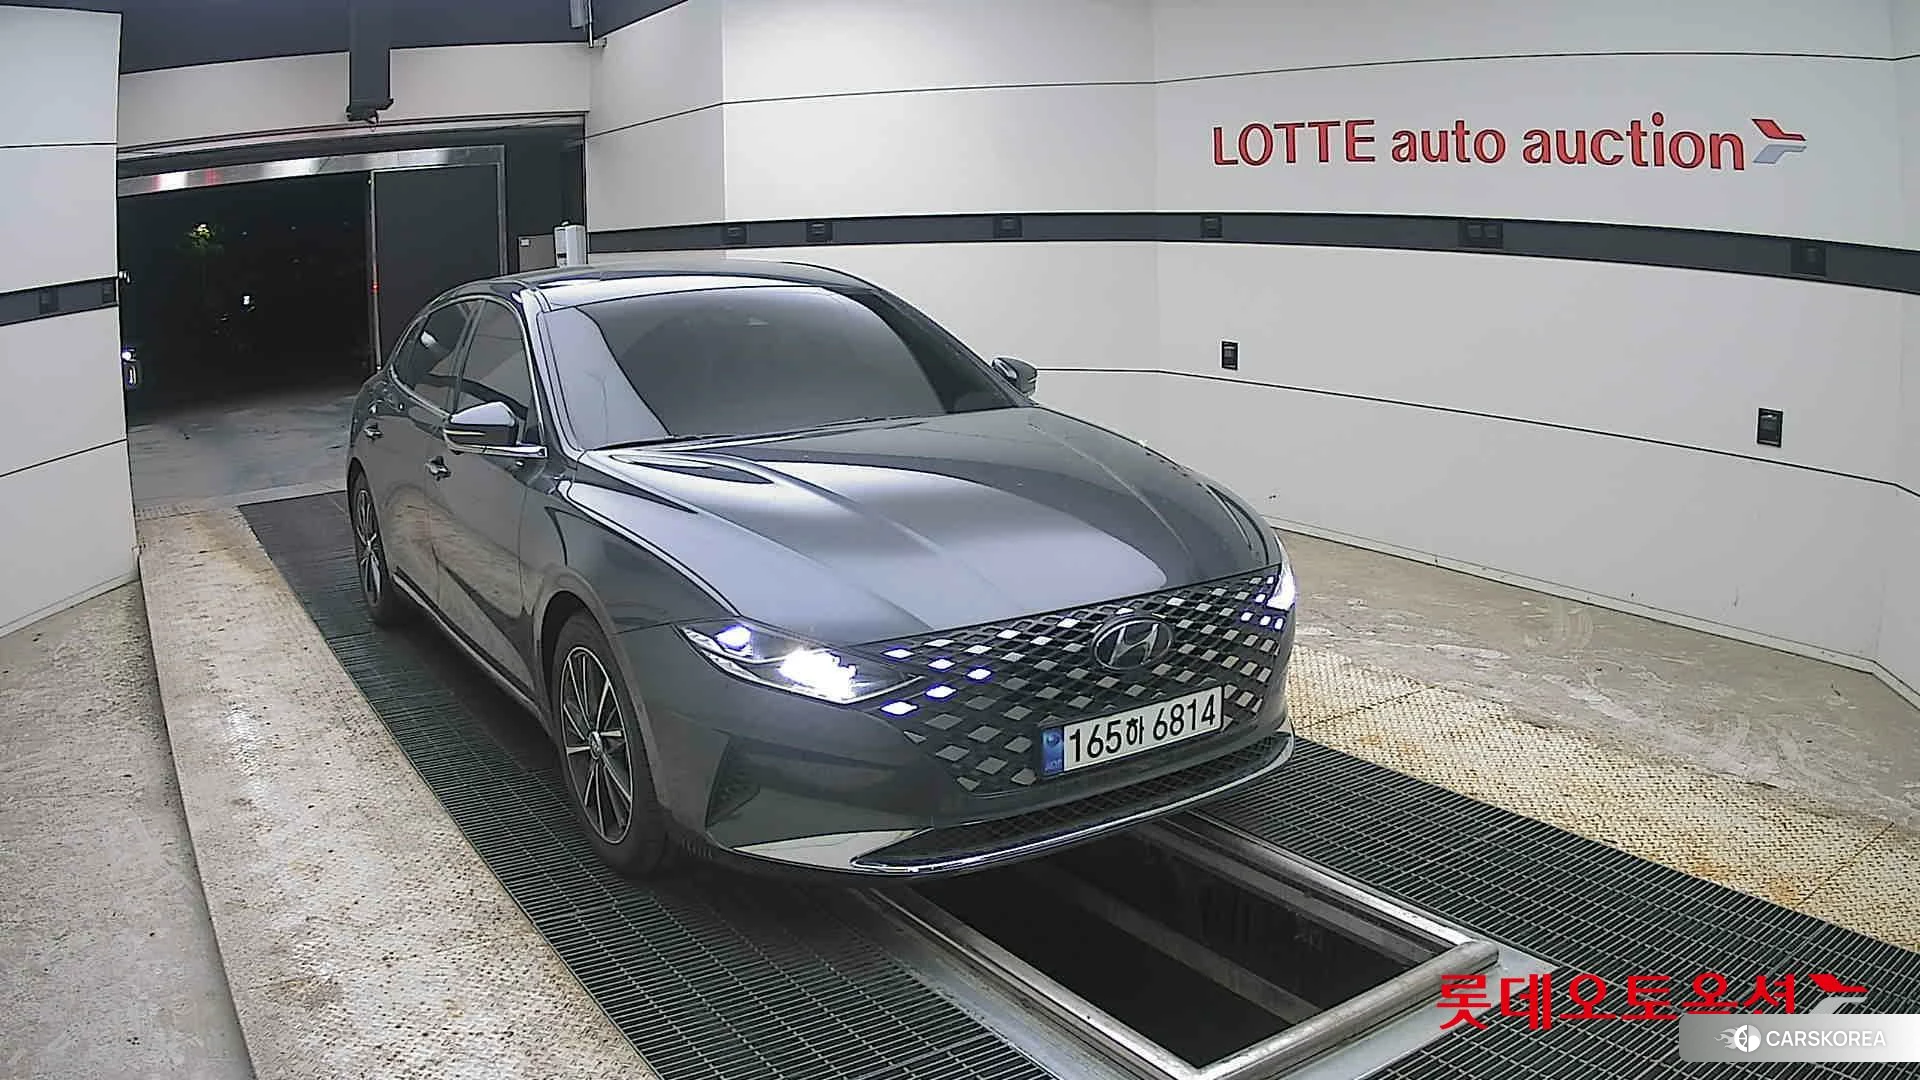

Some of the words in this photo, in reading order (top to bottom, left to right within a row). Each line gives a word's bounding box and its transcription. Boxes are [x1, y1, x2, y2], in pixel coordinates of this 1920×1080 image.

[1212, 119, 1376, 166] LOTTE
[1391, 119, 1507, 164] auto
[1522, 111, 1744, 171] auction
[1069, 715, 1145, 763] 165하
[1152, 693, 1217, 742] 6814
